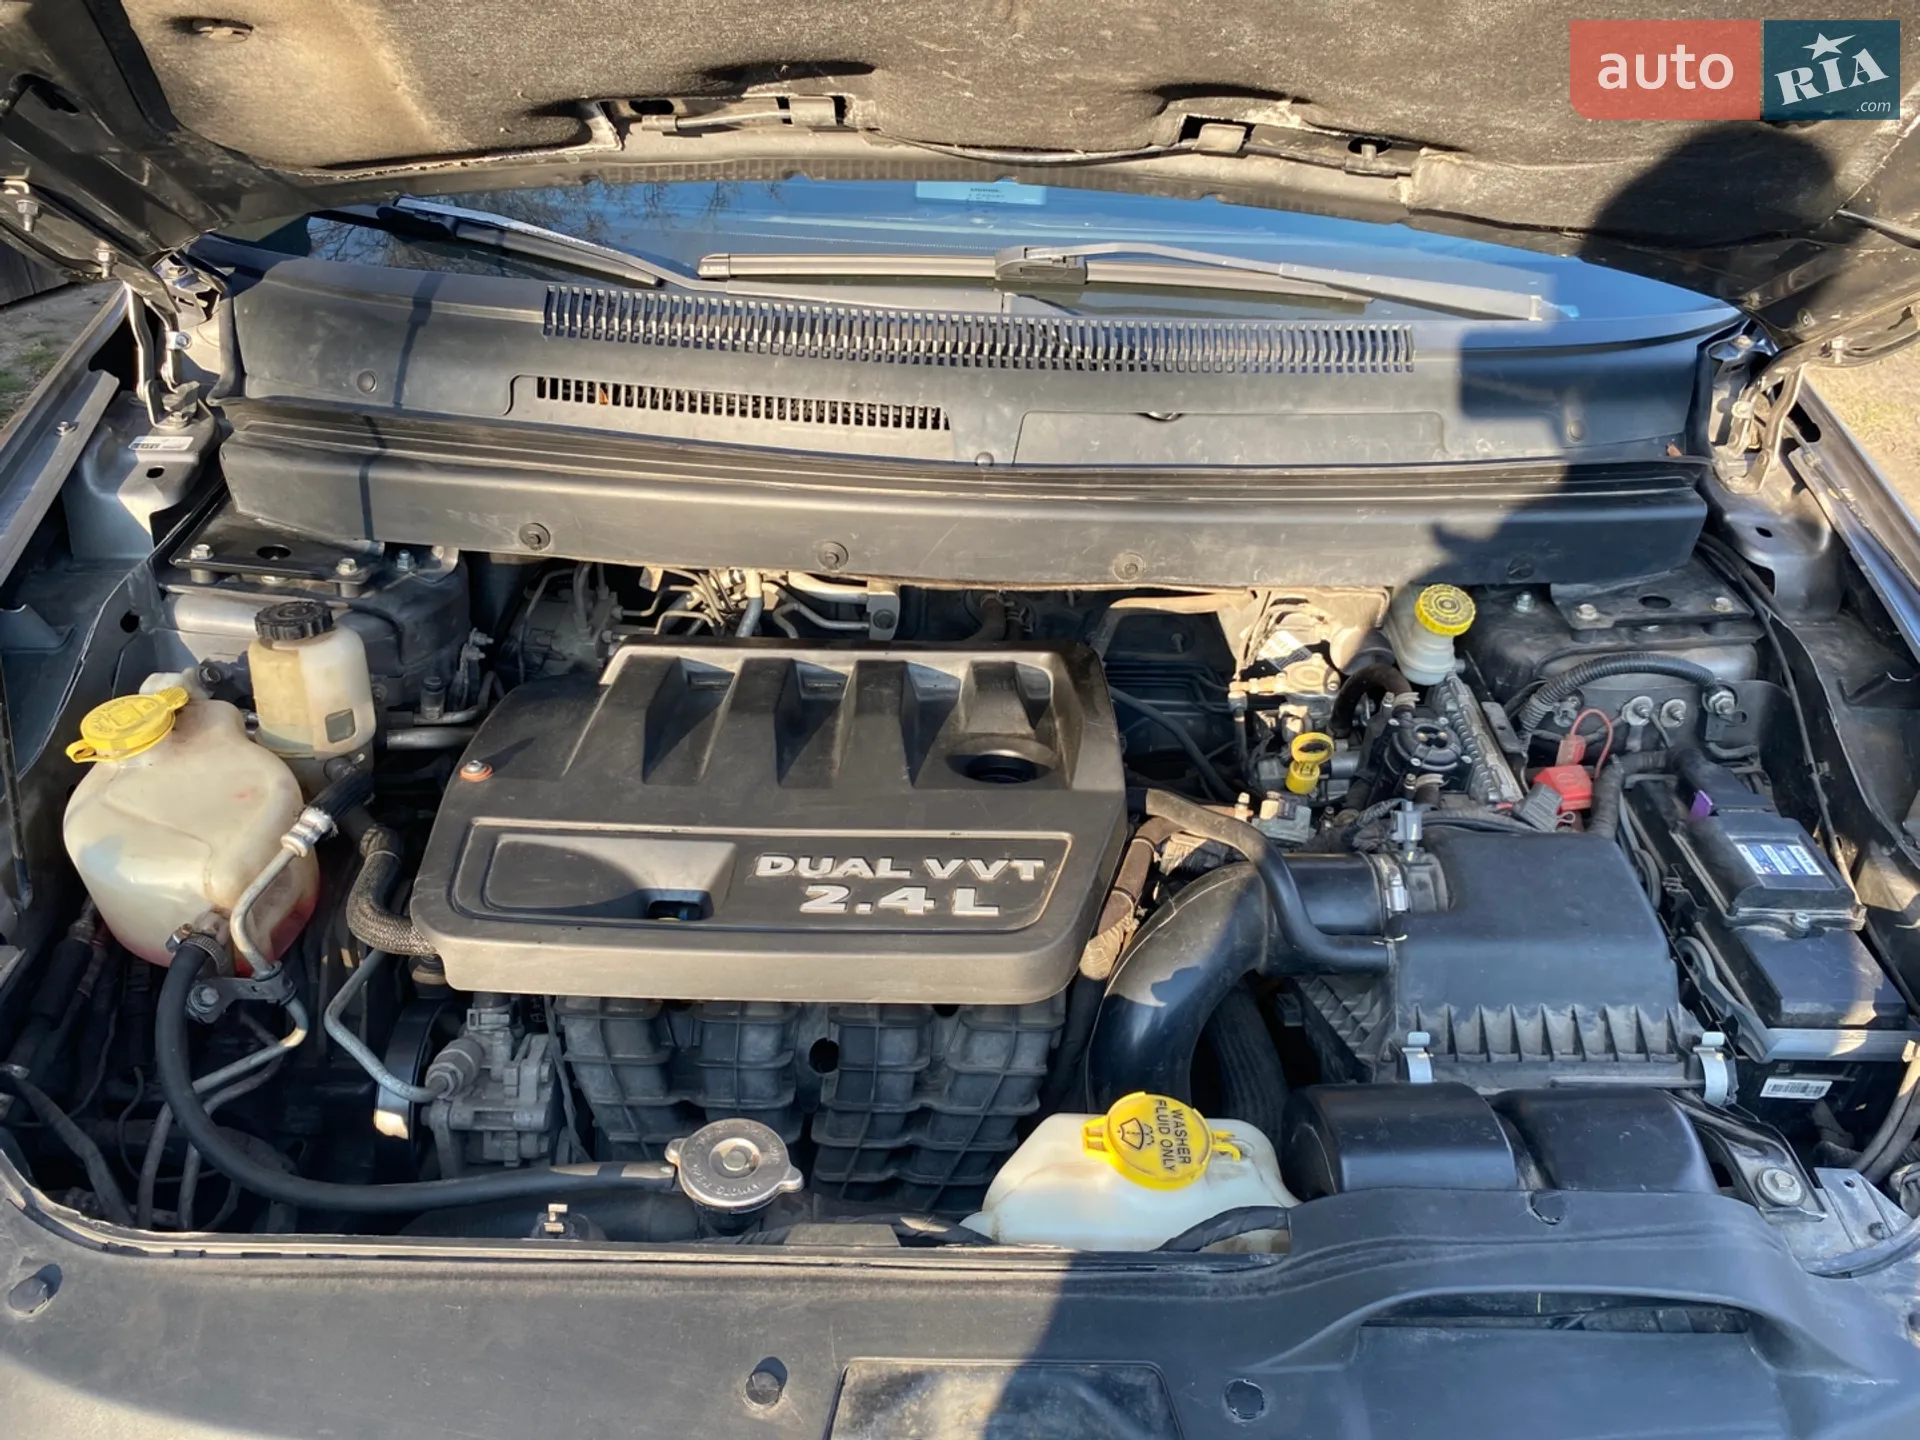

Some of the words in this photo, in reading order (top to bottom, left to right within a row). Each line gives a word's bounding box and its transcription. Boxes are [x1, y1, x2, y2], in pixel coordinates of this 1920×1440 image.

[755, 854, 912, 879] DUAL
[924, 857, 1046, 880] VVT
[799, 883, 935, 915] 2.4
[952, 887, 1000, 917] L
[1155, 1099, 1171, 1136] FLUID
[1171, 1109, 1192, 1165] WASHER
[1160, 1140, 1176, 1172] ONLY
